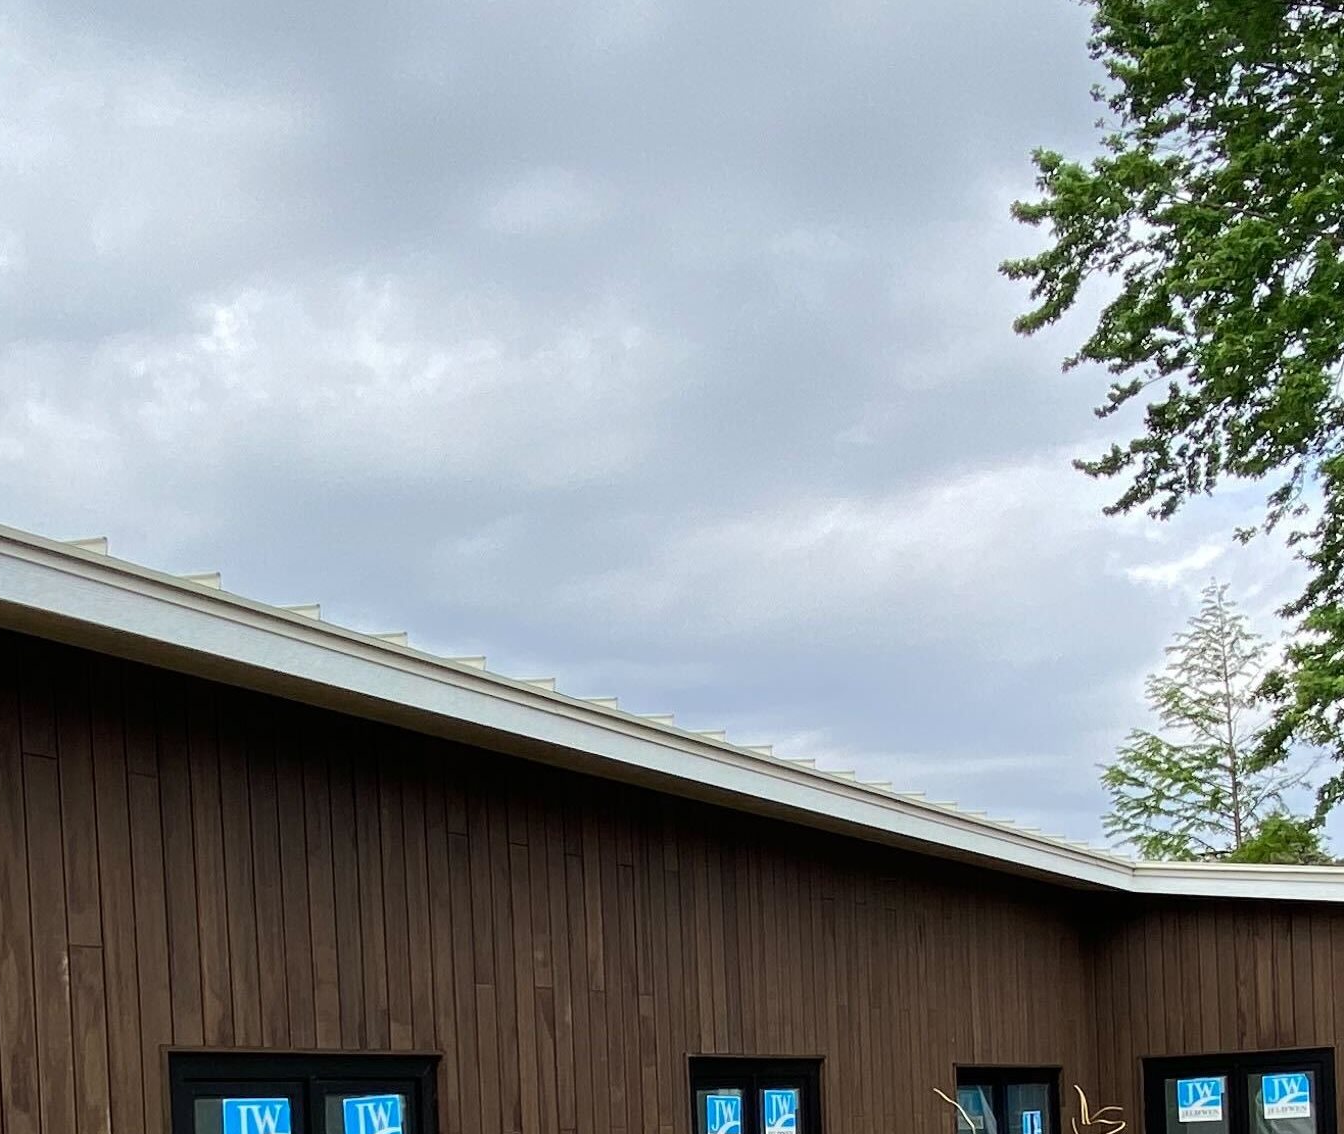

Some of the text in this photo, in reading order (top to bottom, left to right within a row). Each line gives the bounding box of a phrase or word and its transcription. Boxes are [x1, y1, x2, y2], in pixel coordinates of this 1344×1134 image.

[1183, 1081, 1216, 1106] JW
[1267, 1076, 1303, 1102] JW
[711, 1099, 736, 1131] JW
[768, 1094, 792, 1125] JW
